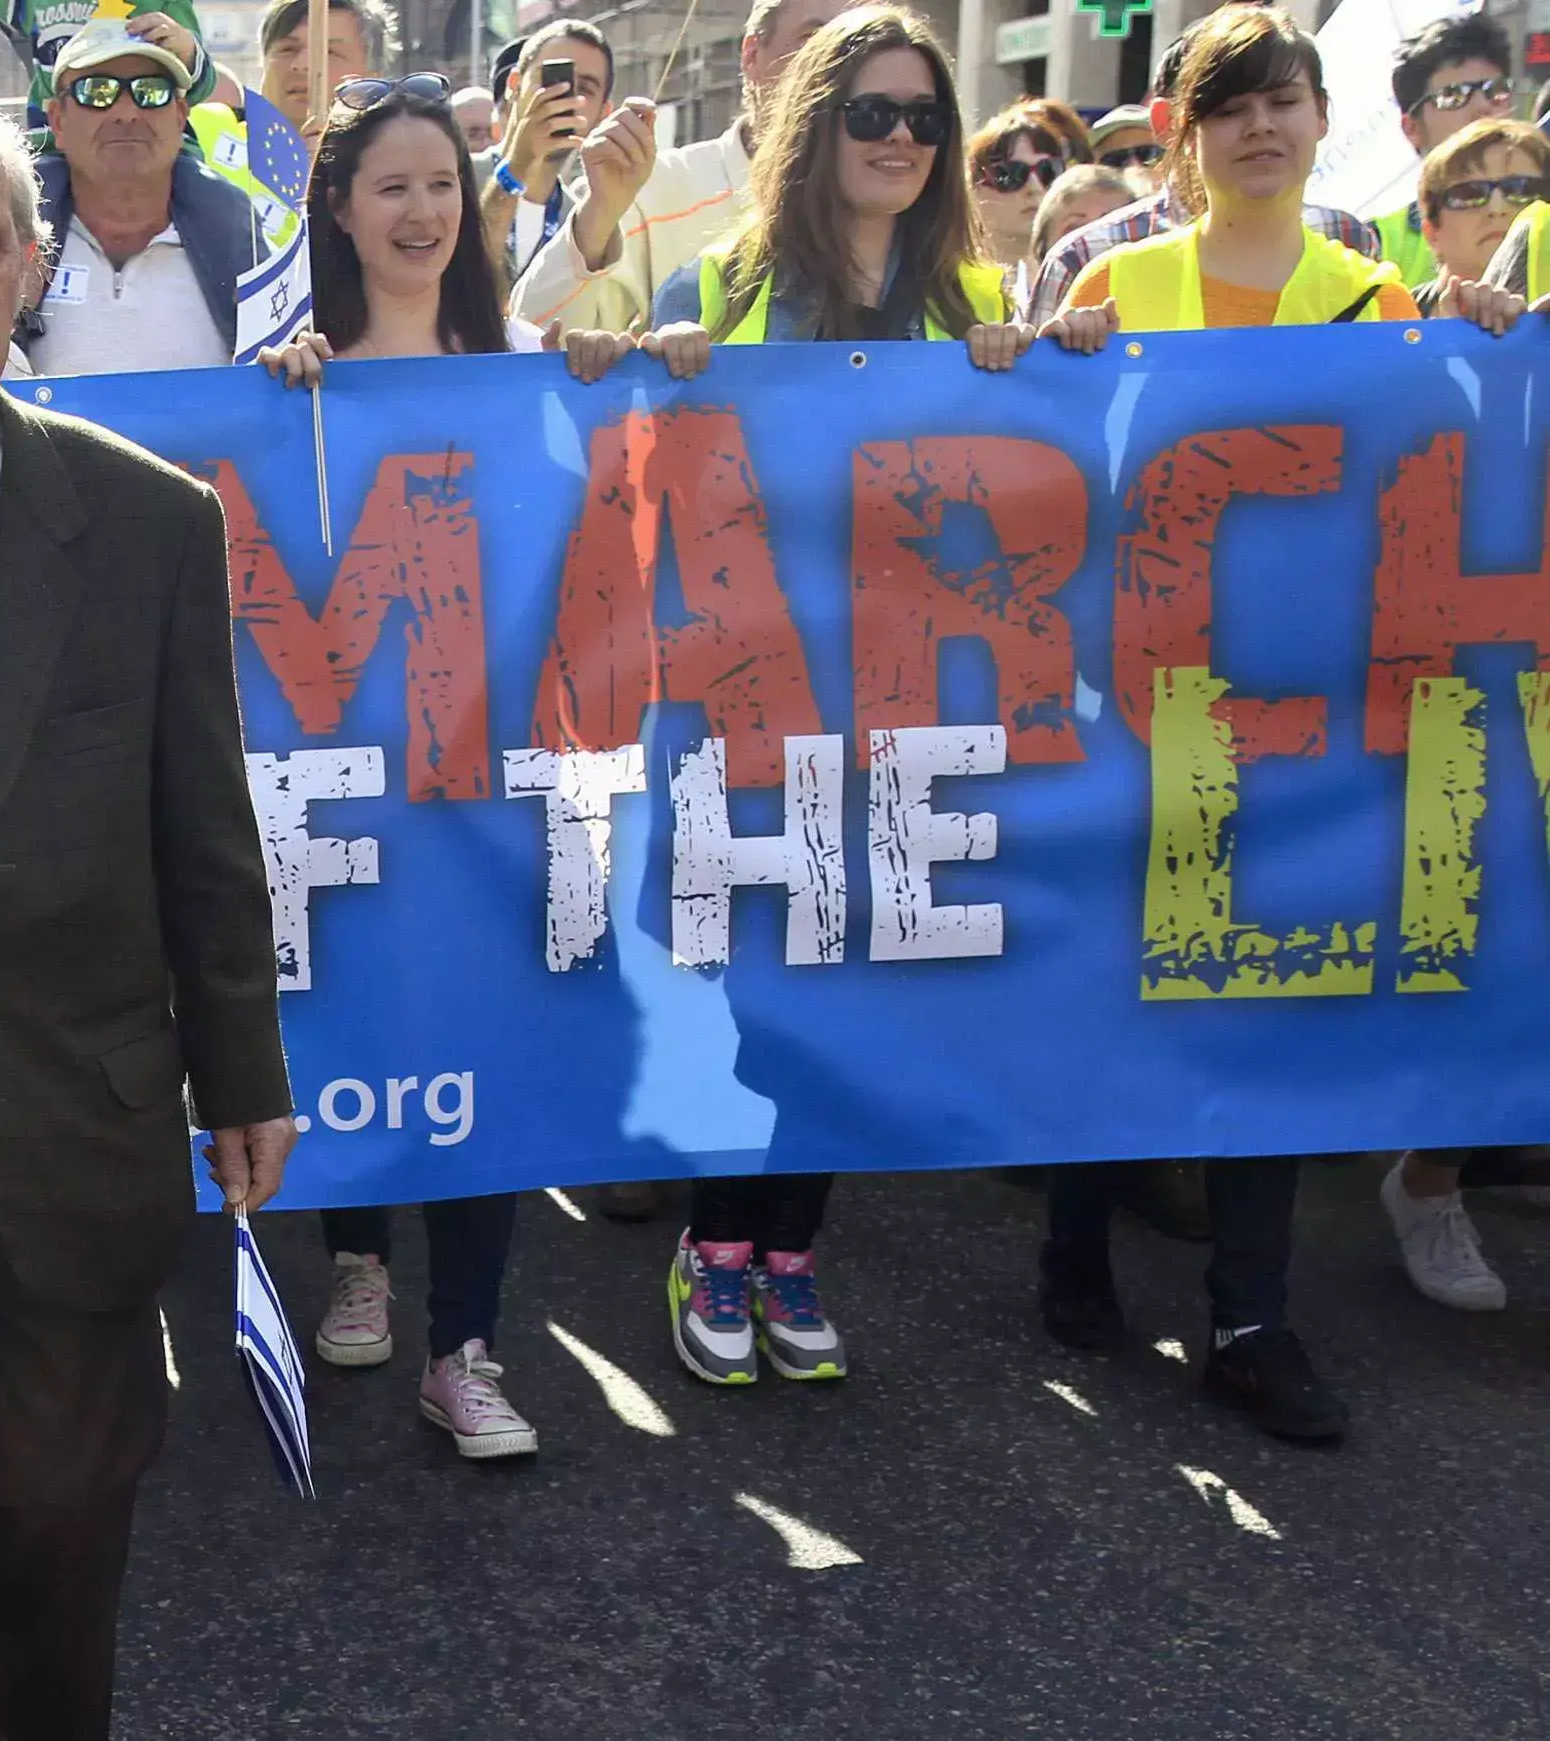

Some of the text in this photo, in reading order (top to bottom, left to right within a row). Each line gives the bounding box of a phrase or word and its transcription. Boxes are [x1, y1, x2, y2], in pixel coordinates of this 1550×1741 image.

[175, 404, 1550, 802] MARCH
[244, 666, 1550, 1001] F THE LI
[294, 1070, 475, 1147] .org
